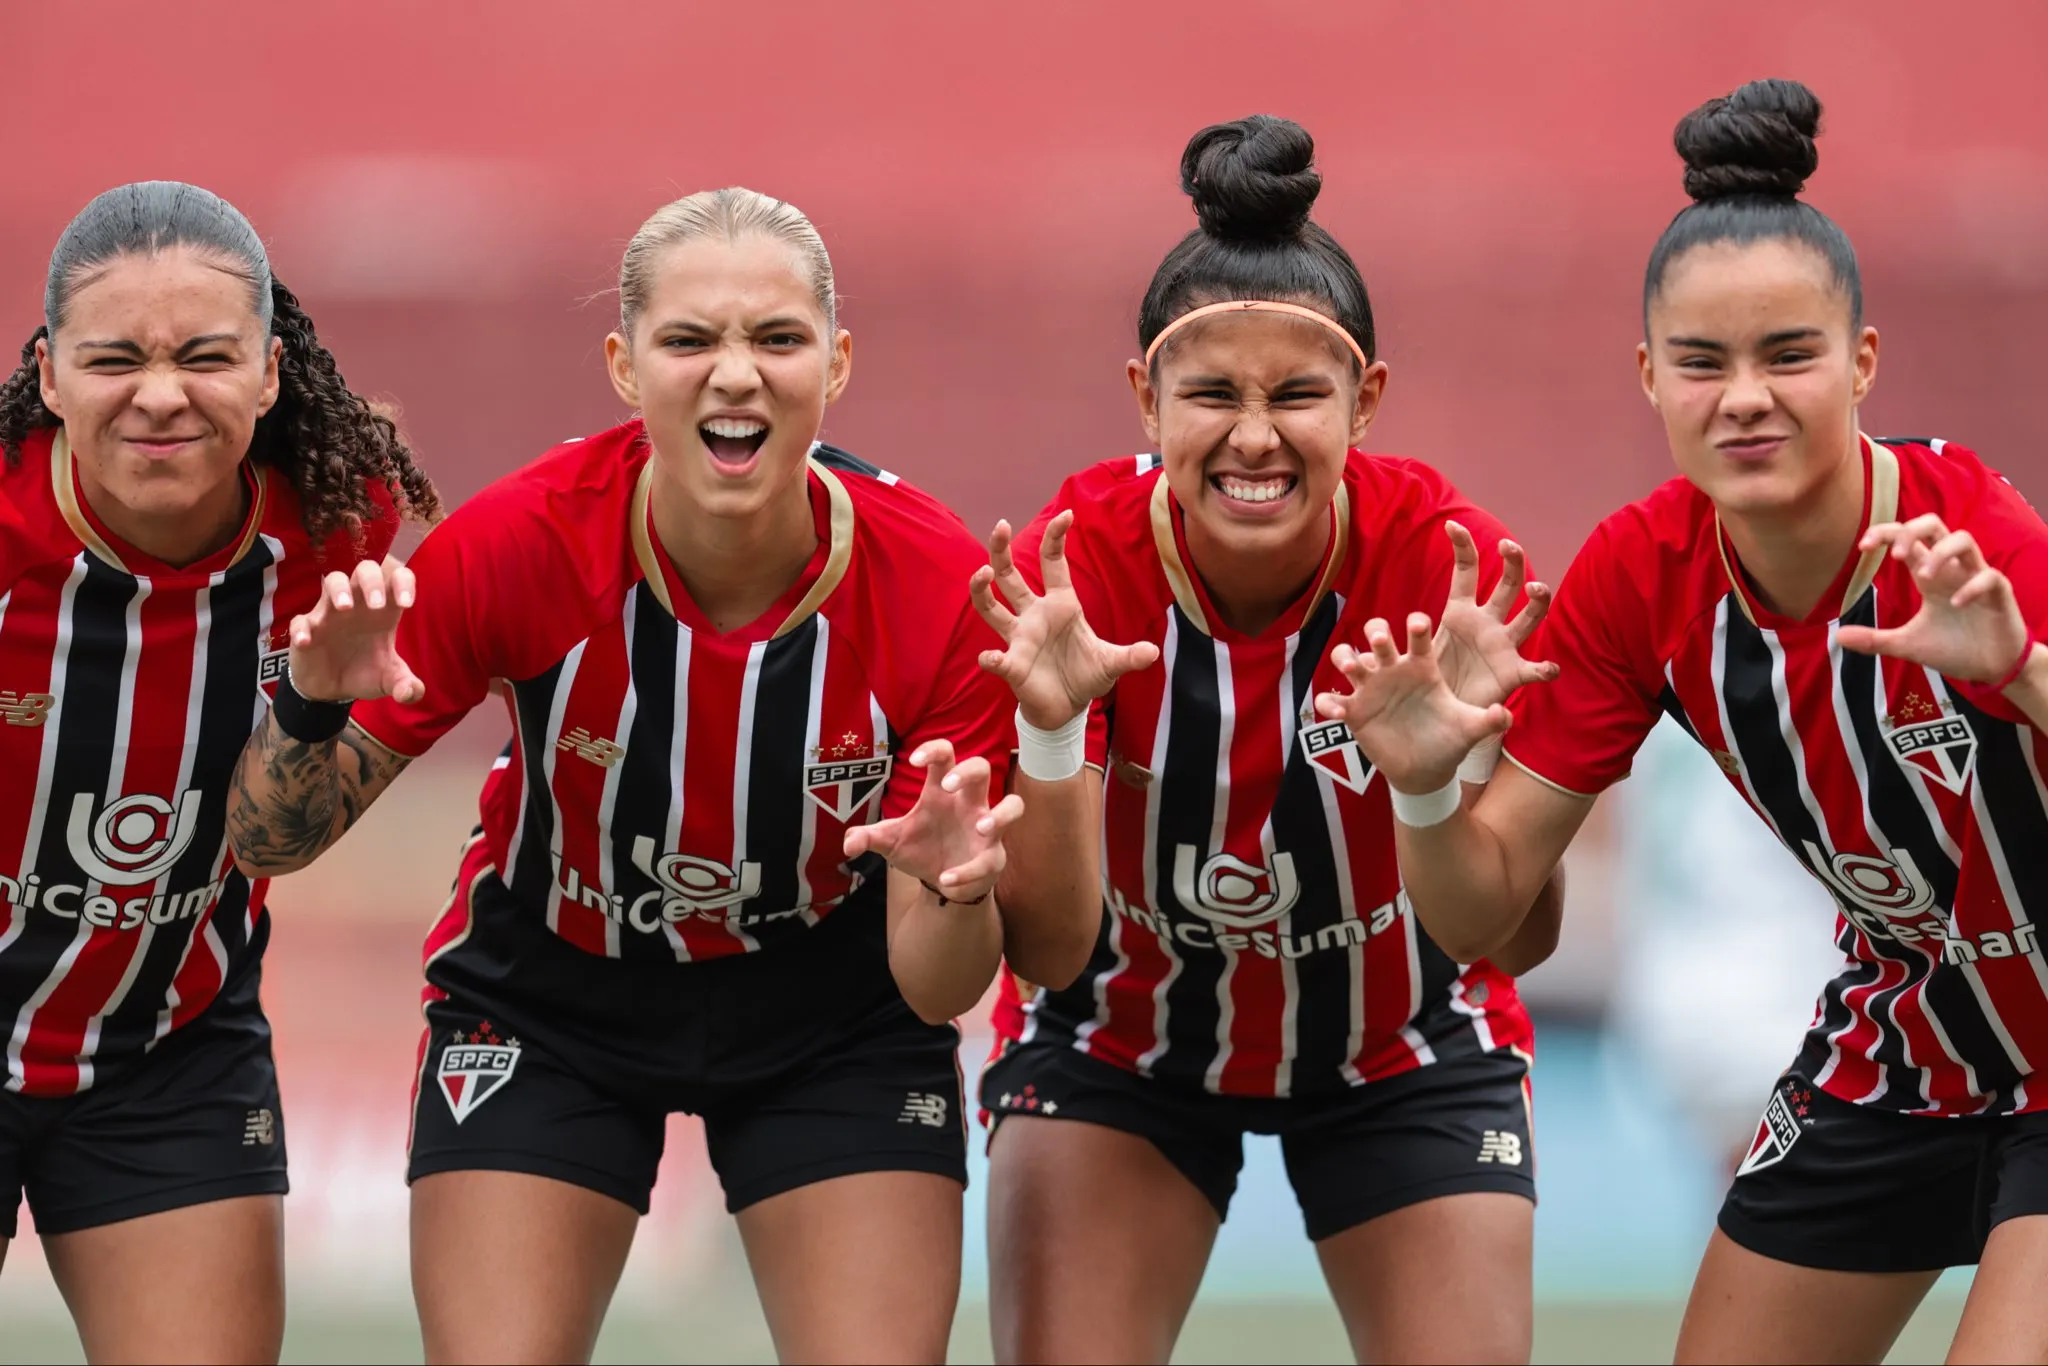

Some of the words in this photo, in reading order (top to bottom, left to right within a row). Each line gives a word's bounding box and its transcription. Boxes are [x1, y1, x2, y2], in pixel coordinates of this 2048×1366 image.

[263, 656, 290, 678] SP
[1308, 724, 1353, 751] SP
[1895, 723, 1965, 750] SPFC
[810, 761, 883, 784] SPFC
[0, 872, 219, 931] niCesum
[445, 1051, 509, 1070] SPFC
[1768, 1100, 1794, 1147] SPFC
